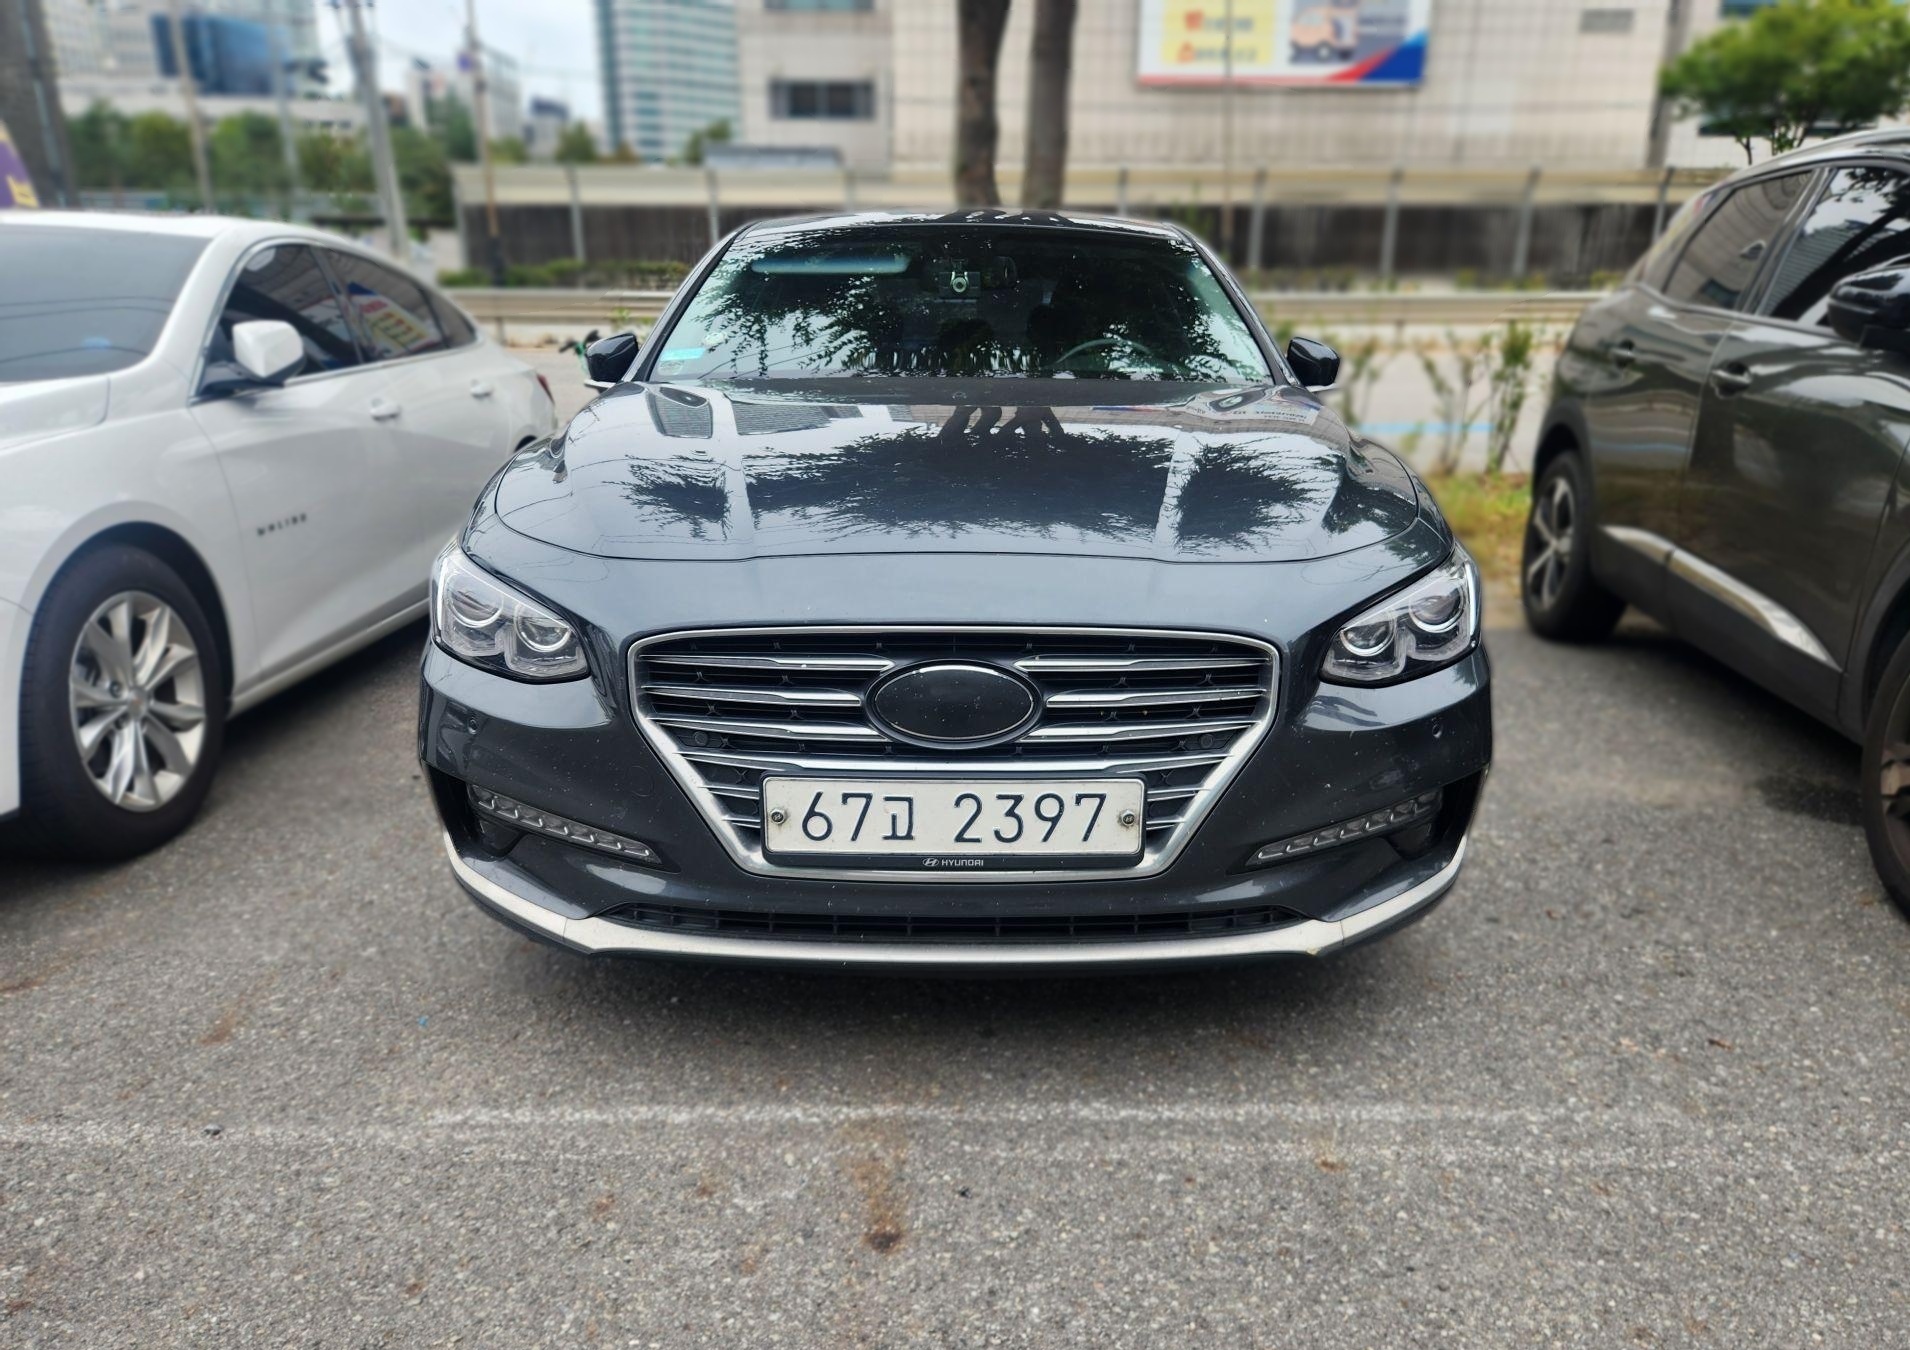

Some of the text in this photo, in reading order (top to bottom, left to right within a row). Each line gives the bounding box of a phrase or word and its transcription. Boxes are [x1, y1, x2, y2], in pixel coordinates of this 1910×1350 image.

[801, 791, 1107, 843] 67고 2397
[941, 859, 984, 867] HYUNDAI
